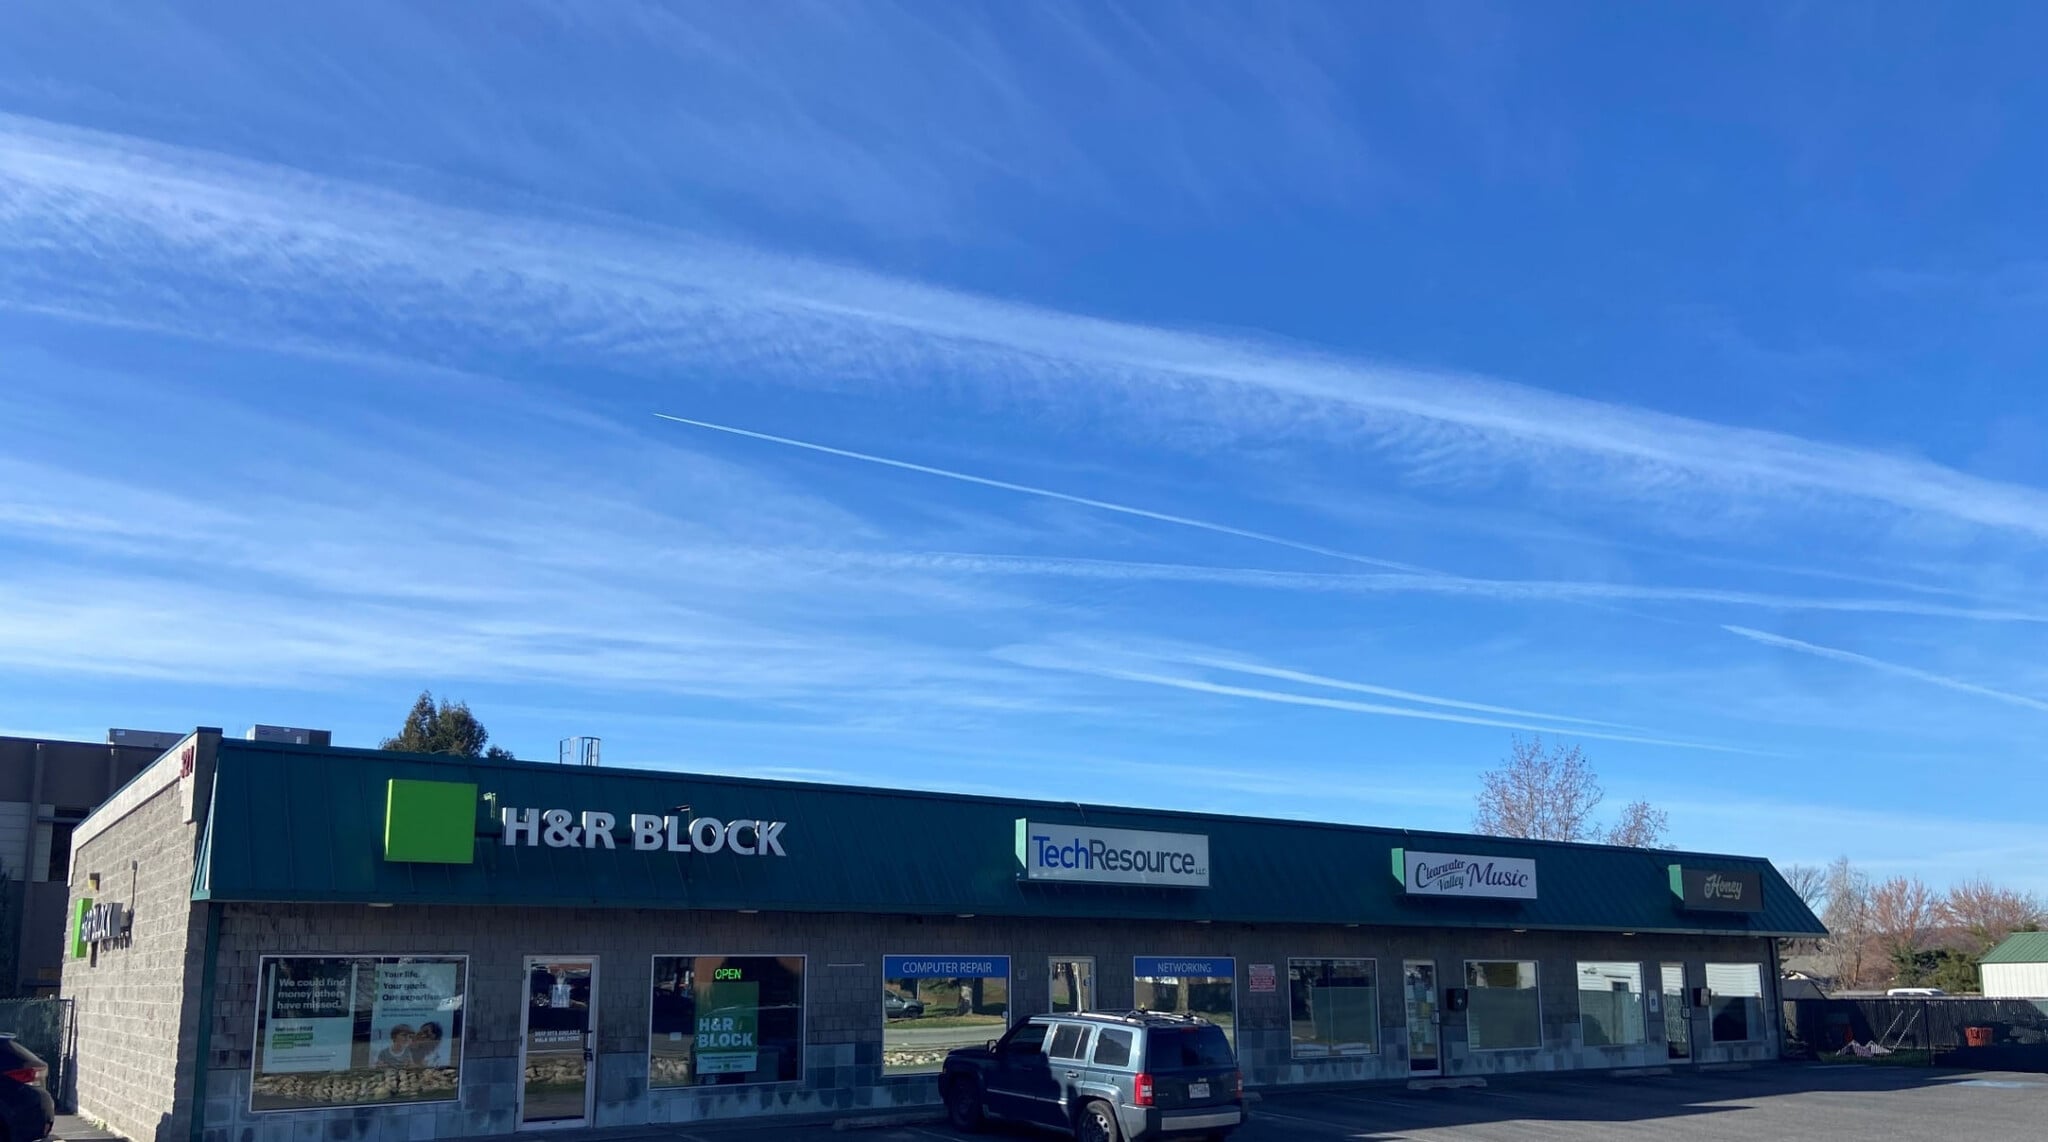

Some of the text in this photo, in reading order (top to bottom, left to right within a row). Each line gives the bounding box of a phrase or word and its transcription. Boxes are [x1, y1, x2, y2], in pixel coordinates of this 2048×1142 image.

[502, 807, 787, 857] H&R BLOCK
[1032, 835, 1195, 875] TechResource
[1415, 859, 1465, 888] Clearwater
[1466, 862, 1528, 888] Music
[1437, 875, 1464, 892] Valley
[1704, 874, 1742, 900] Honey
[714, 968, 742, 980] OPEN
[902, 961, 993, 974] COMPUTER REPAIR
[1157, 962, 1212, 974] NETWORKING
[280, 978, 346, 987] We could find
[383, 982, 402, 990] Your
[278, 989, 345, 1000] money others
[277, 1000, 342, 1010] have missed.
[699, 1018, 734, 1032] H&R
[698, 1033, 753, 1048] BLOCK
